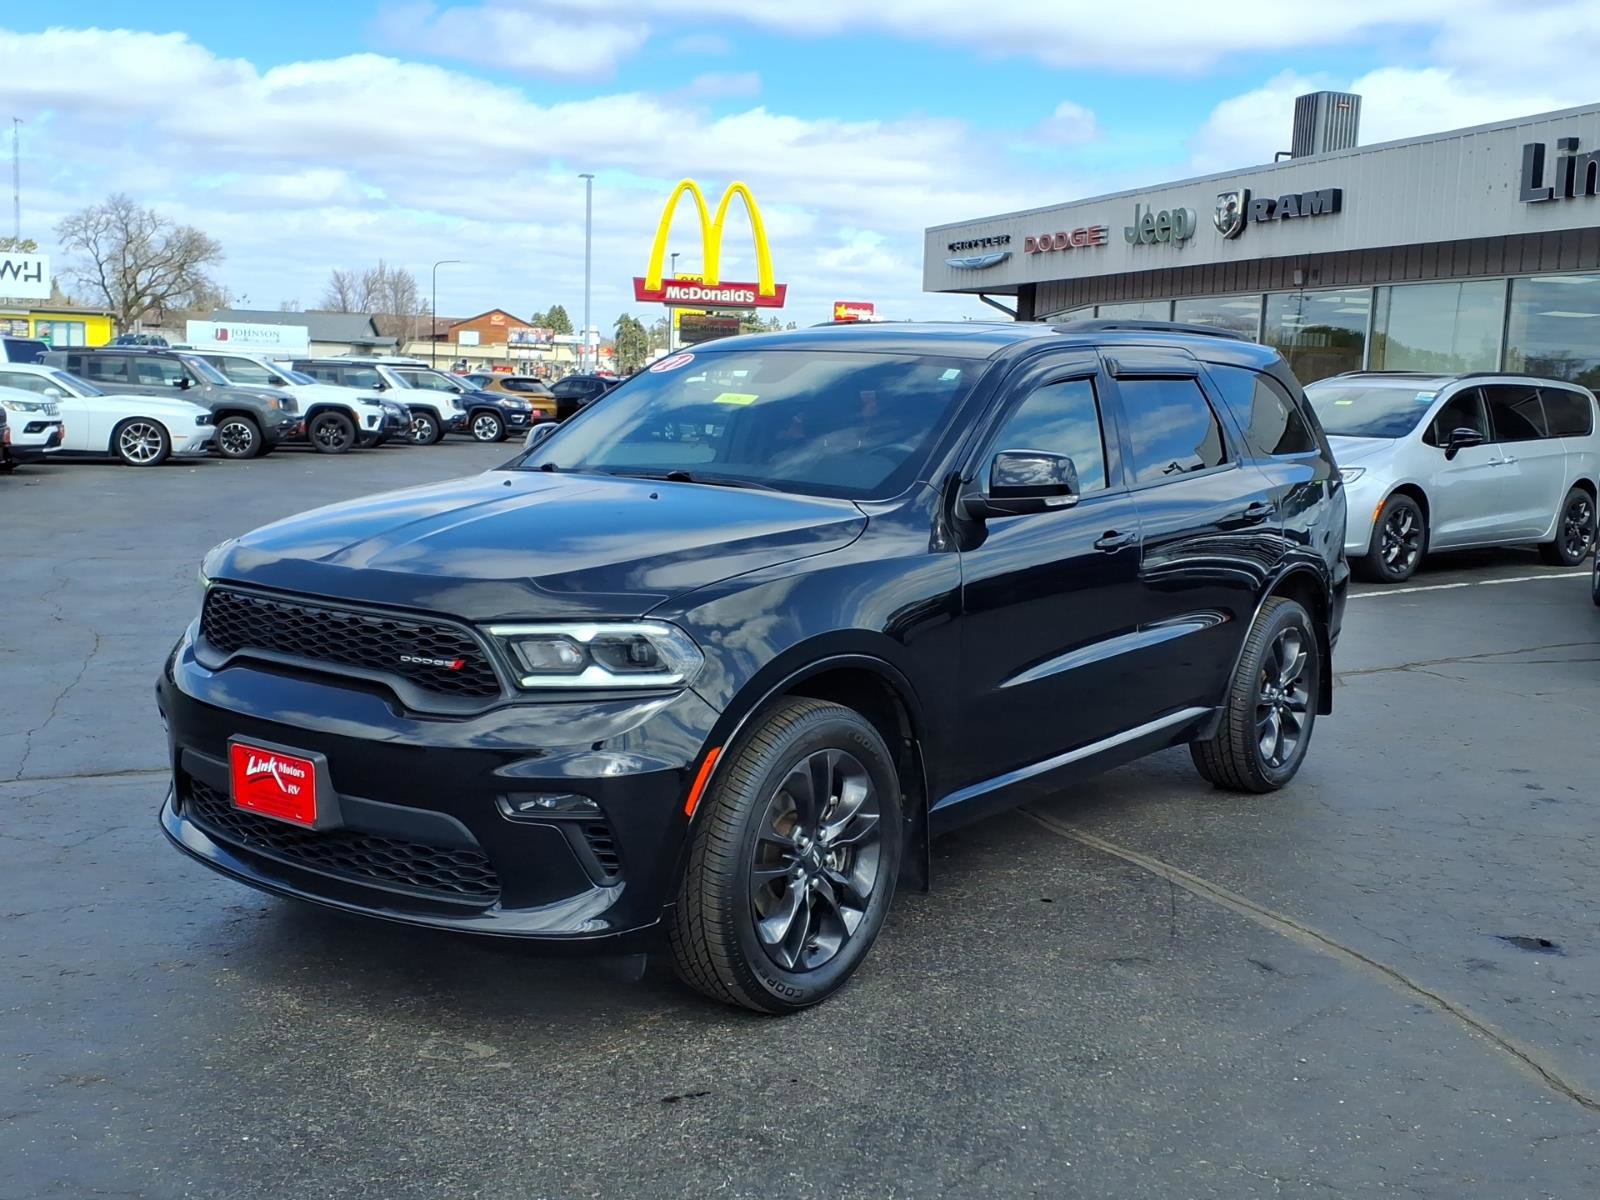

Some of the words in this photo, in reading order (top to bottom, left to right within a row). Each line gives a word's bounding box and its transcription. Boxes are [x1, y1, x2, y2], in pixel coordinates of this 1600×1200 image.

[1250, 188, 1342, 222] RAM
[1123, 203, 1196, 246] Jeep
[948, 235, 1011, 252] CHRYSLER
[1024, 225, 1108, 254] DODGE
[665, 286, 755, 303] McDonald's
[231, 327, 280, 339] JOHNSON
[400, 655, 456, 667] DODGE
[279, 762, 305, 778] Motors
[287, 784, 301, 795] RV
